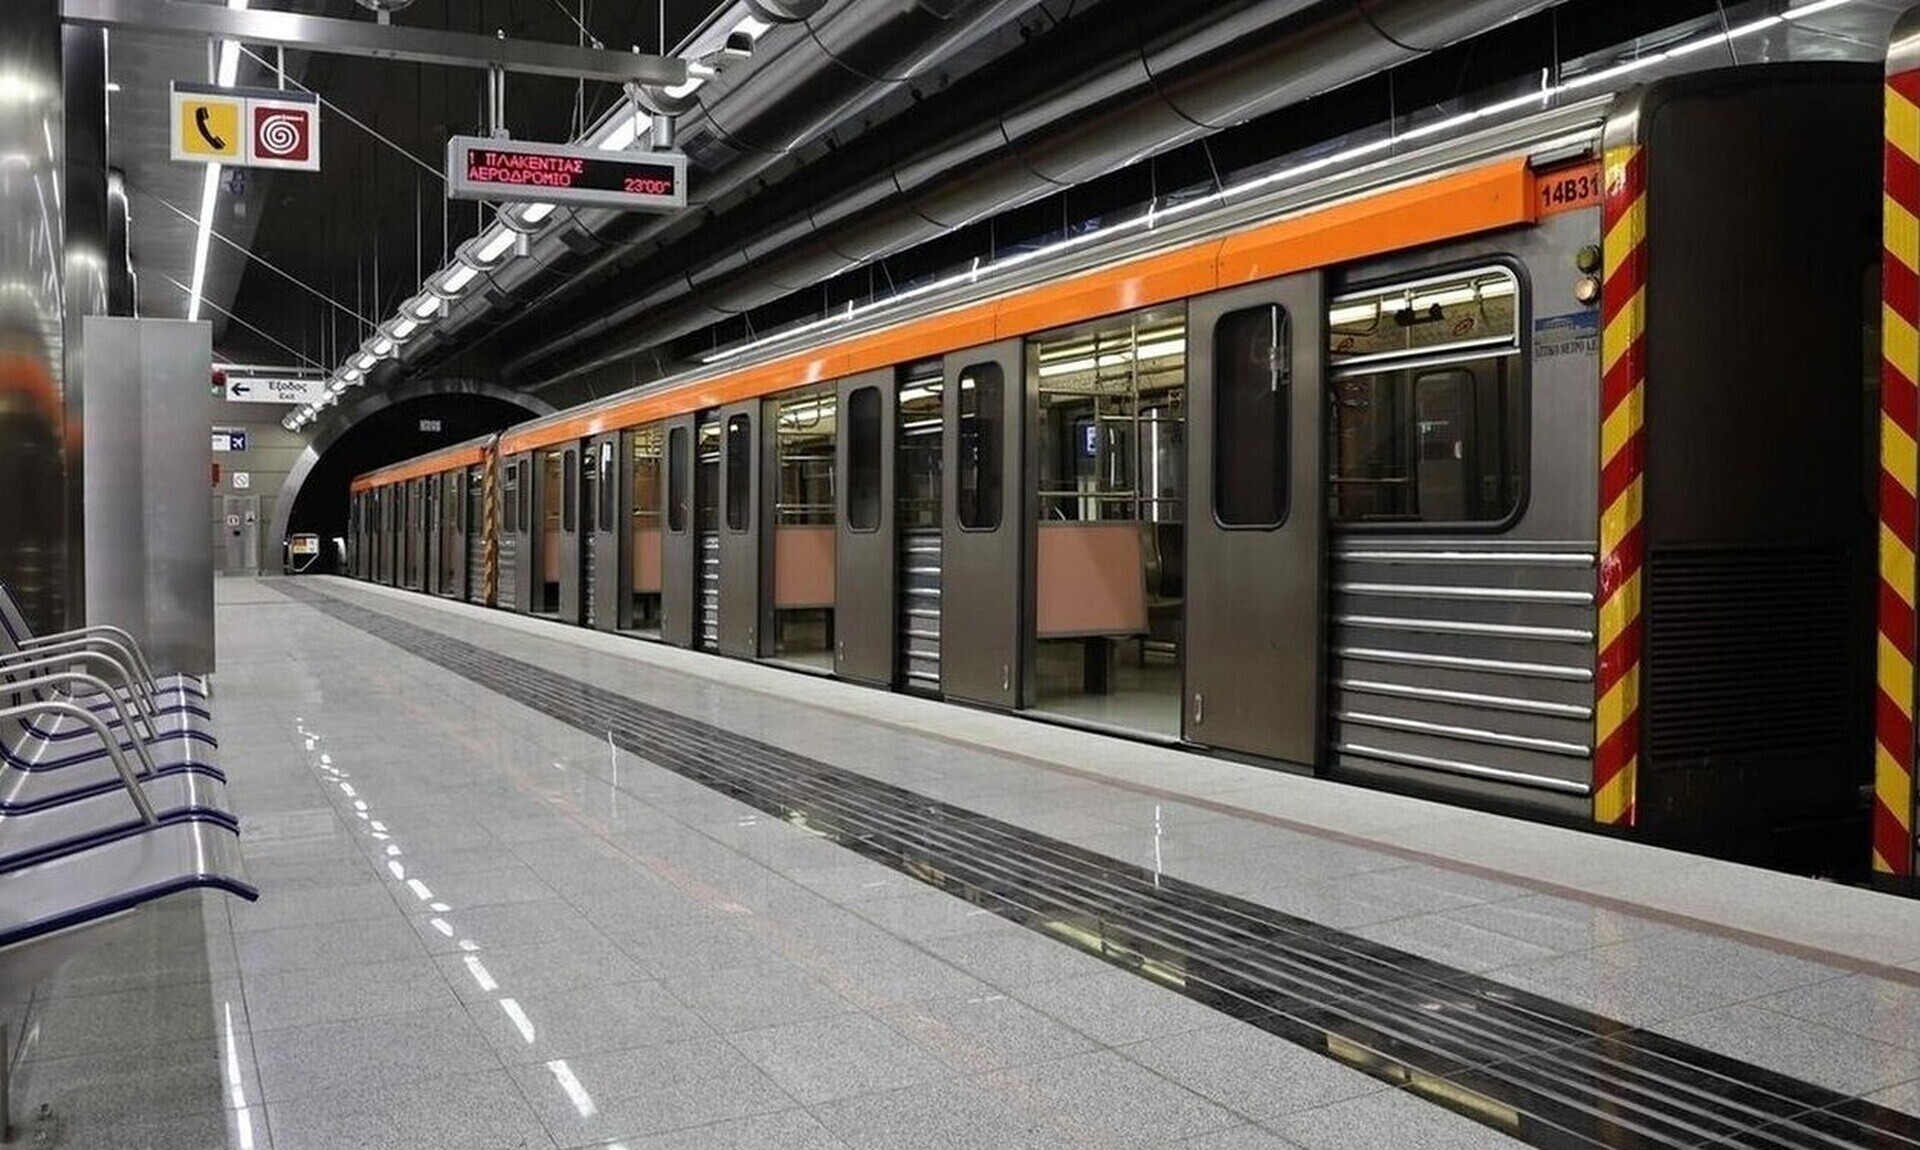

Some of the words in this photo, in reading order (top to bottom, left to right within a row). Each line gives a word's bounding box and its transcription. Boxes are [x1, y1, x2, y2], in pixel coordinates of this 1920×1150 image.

[485, 152, 583, 174] ΠΛΑΚΕΝΤΙΑΣ
[469, 166, 571, 187] ΑΕΡΟΔΡΟΜΙΟ
[1541, 172, 1599, 207] 14B31
